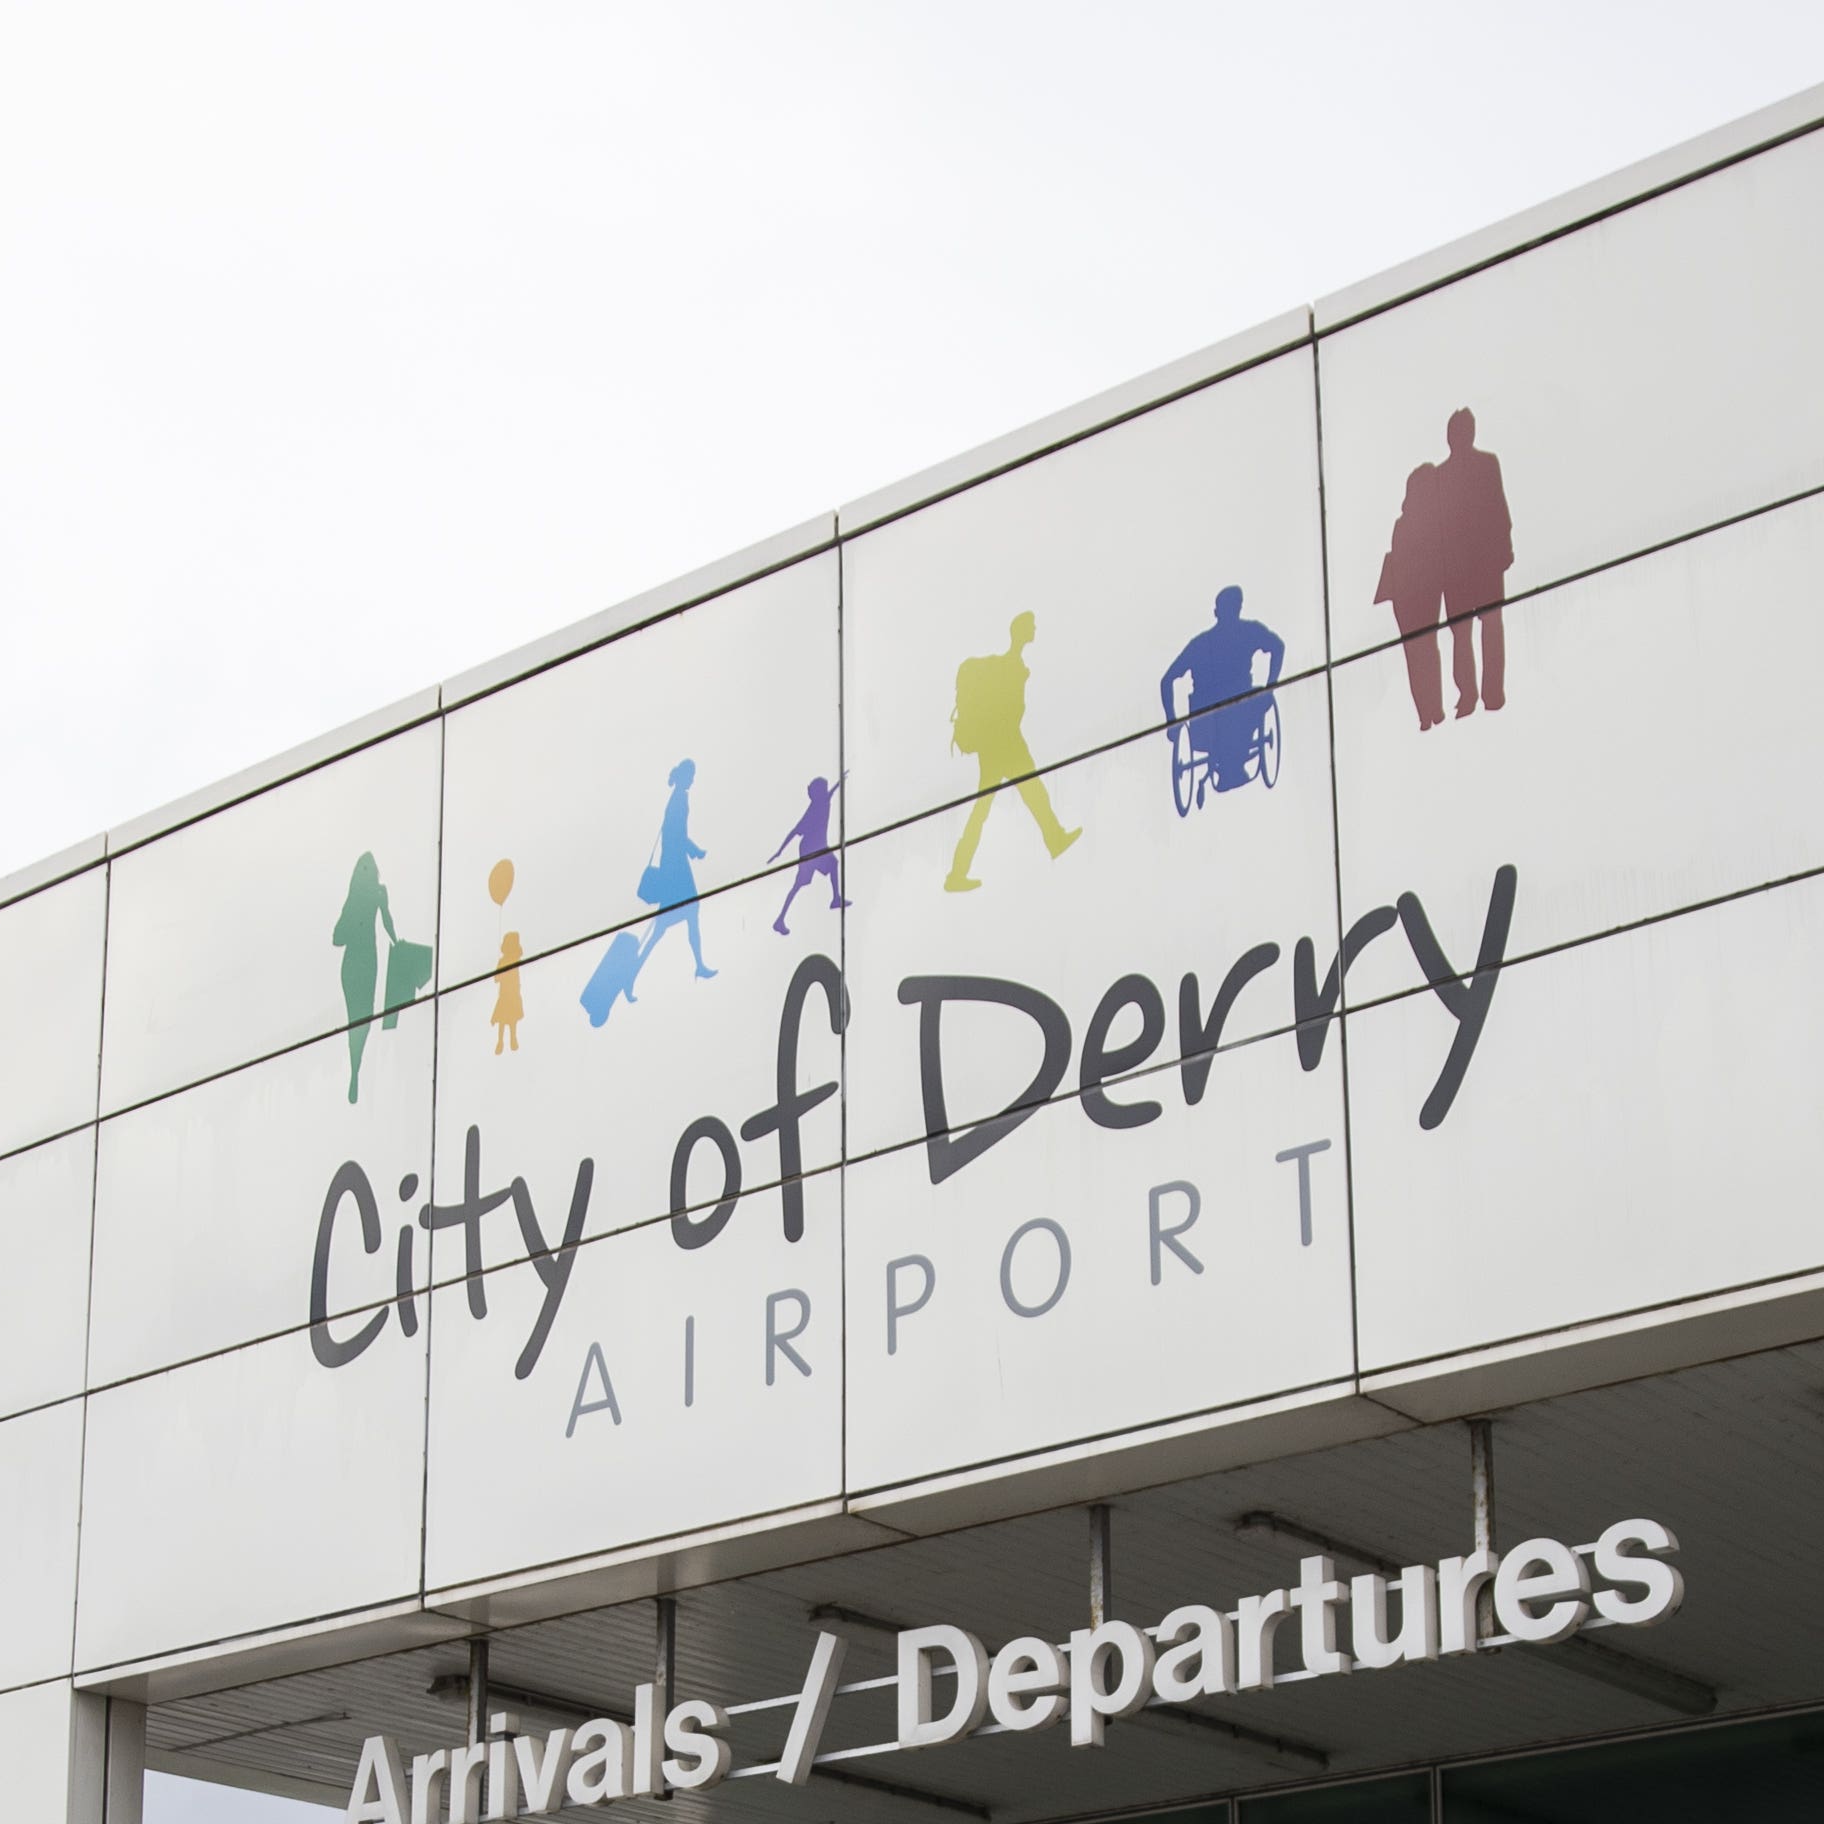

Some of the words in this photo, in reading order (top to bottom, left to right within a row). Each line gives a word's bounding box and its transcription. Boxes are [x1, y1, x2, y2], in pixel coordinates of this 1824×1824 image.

[307, 1122, 594, 1381] City
[666, 951, 852, 1251] of
[895, 862, 1518, 1186] Derry
[564, 1138, 1333, 1440] AIRPORT
[776, 1631, 847, 1786] /
[896, 1517, 1685, 1748] Departures
